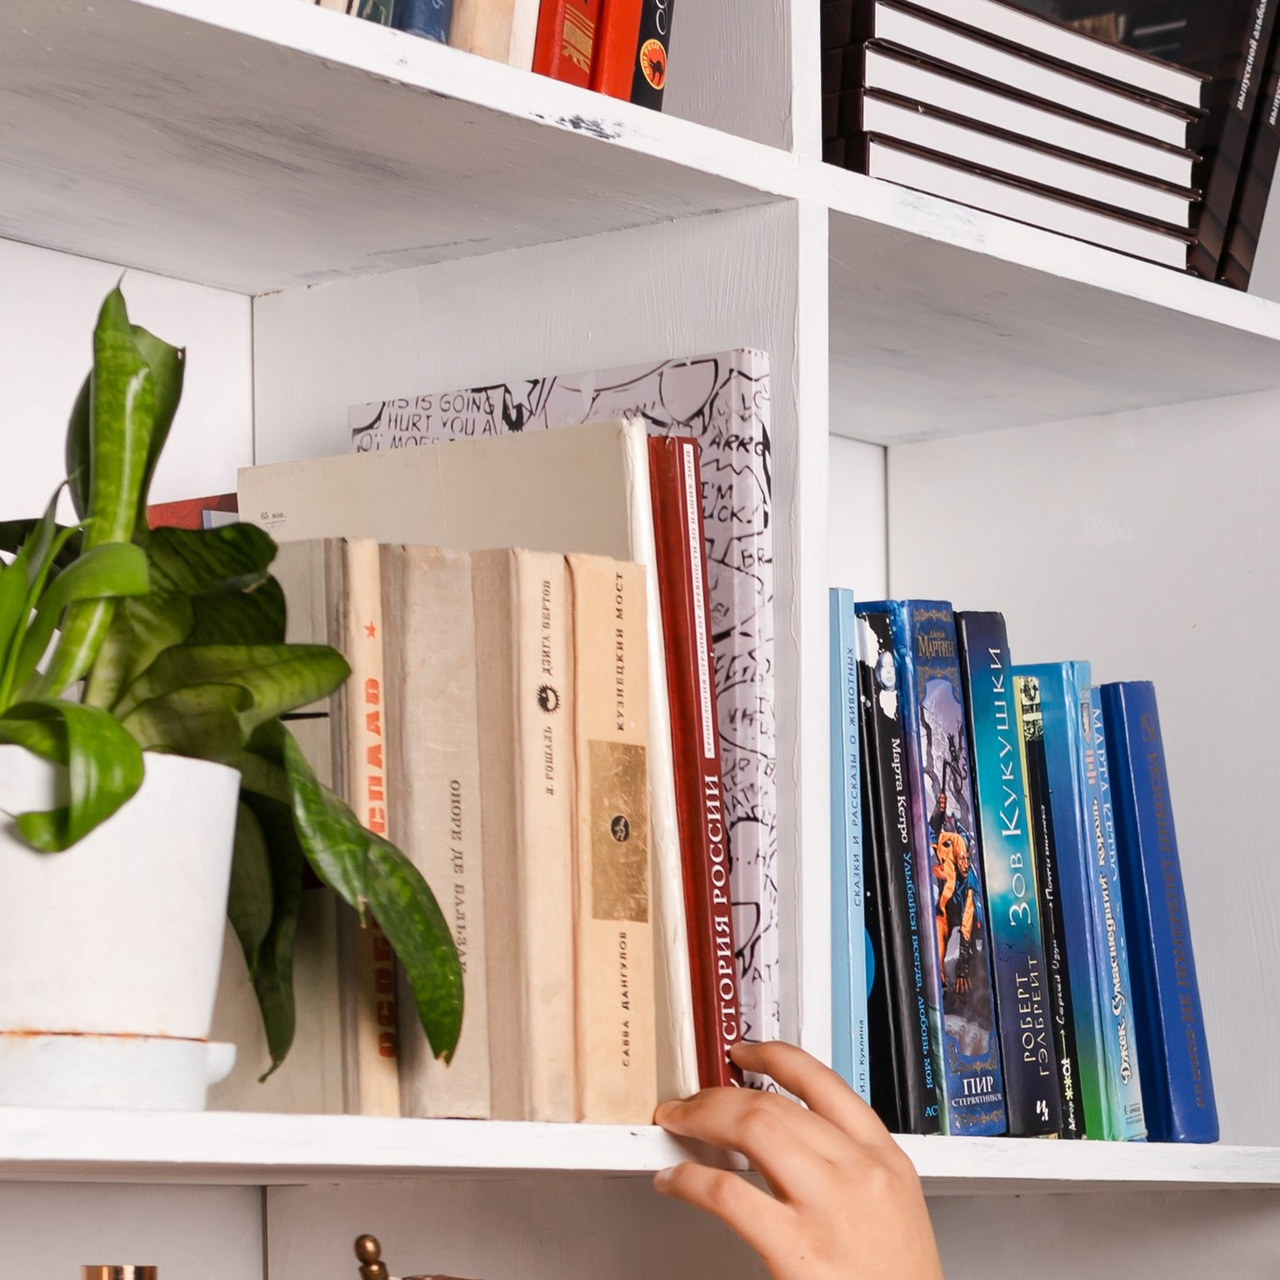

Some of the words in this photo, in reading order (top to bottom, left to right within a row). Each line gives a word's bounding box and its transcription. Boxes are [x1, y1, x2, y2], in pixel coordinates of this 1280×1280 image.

[1236, 38, 1258, 111] выпускной
[687, 482, 697, 525] НАШИХ
[616, 571, 624, 620] МОСТ
[692, 546, 703, 611] ДРЕВНОСТИ
[697, 630, 707, 676] СТРАНЫ
[701, 678, 712, 753] ХРОНОЛОГИЯ
[848, 647, 856, 727] ЖИВОТНЫХ
[364, 678, 388, 834] СПЛАВ
[850, 734, 857, 745] О
[891, 738, 902, 793] Марта
[1092, 708, 1110, 793] МАРТА
[450, 780, 462, 841] ОНОРЕ
[850, 753, 858, 826] РАССКАЗЫ
[896, 795, 909, 844] Кетро
[451, 846, 464, 874] ДЕ
[704, 774, 728, 905] РОССИИ
[1092, 797, 1107, 867] король
[903, 852, 917, 931] Улыбайся
[619, 932, 630, 1010] ДАНГУЛОВ
[912, 934, 923, 994] всегда,
[1099, 873, 1126, 1017] Сумасшедший
[622, 1020, 630, 1067] САВВА
[917, 996, 929, 1057] любовь
[1015, 973, 1036, 1062] РОБЕРТ
[1028, 955, 1049, 1076] ГЭЛБРЕЙТ
[924, 1059, 934, 1089] моя
[1118, 1016, 1132, 1086] Джек
[962, 1076, 995, 1096] ПИР
